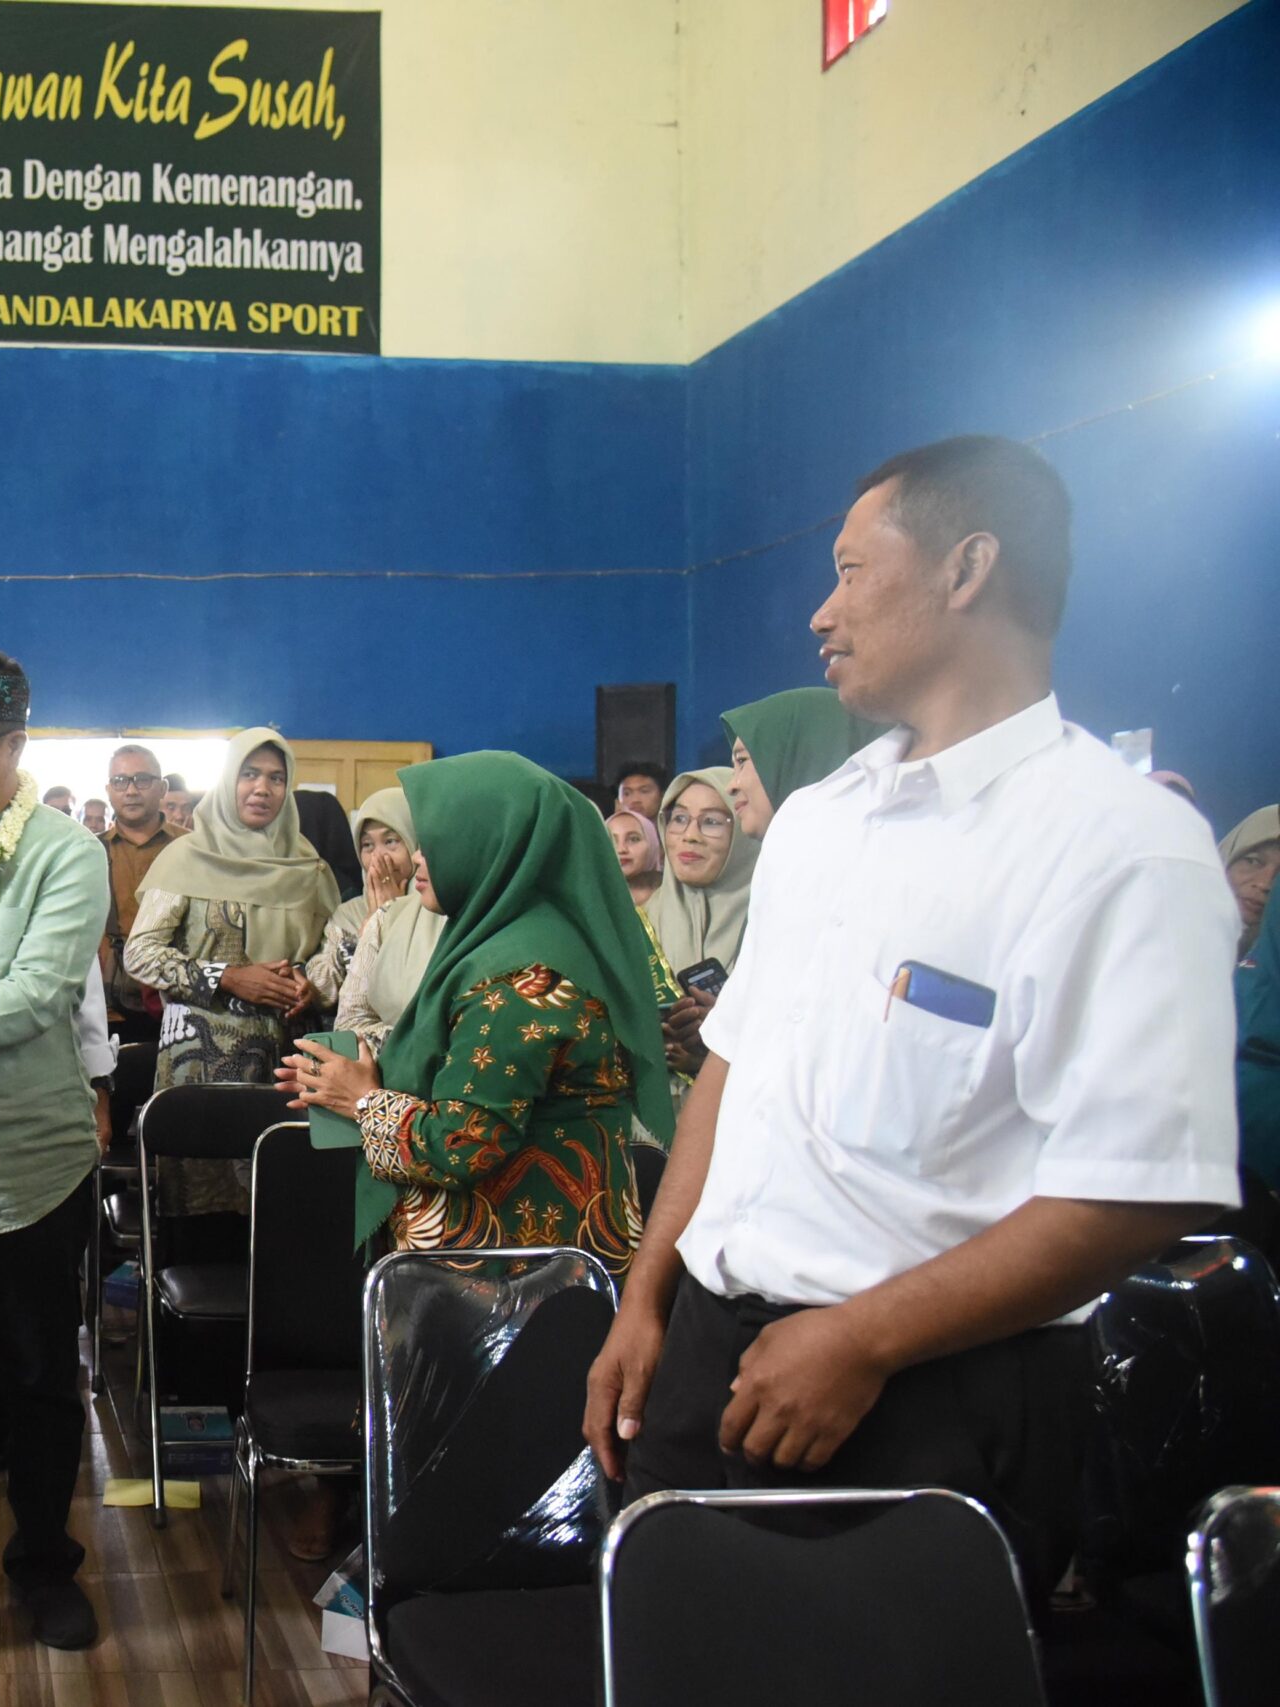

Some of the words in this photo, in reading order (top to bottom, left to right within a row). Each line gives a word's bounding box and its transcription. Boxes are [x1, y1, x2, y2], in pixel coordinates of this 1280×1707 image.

[94, 40, 191, 125] Kita
[194, 38, 346, 141] Susah,
[23, 159, 141, 211] Dengan
[152, 163, 363, 218] Kemenangan.
[103, 223, 363, 282] Mengalahkannya
[247, 301, 363, 337] SPORT
